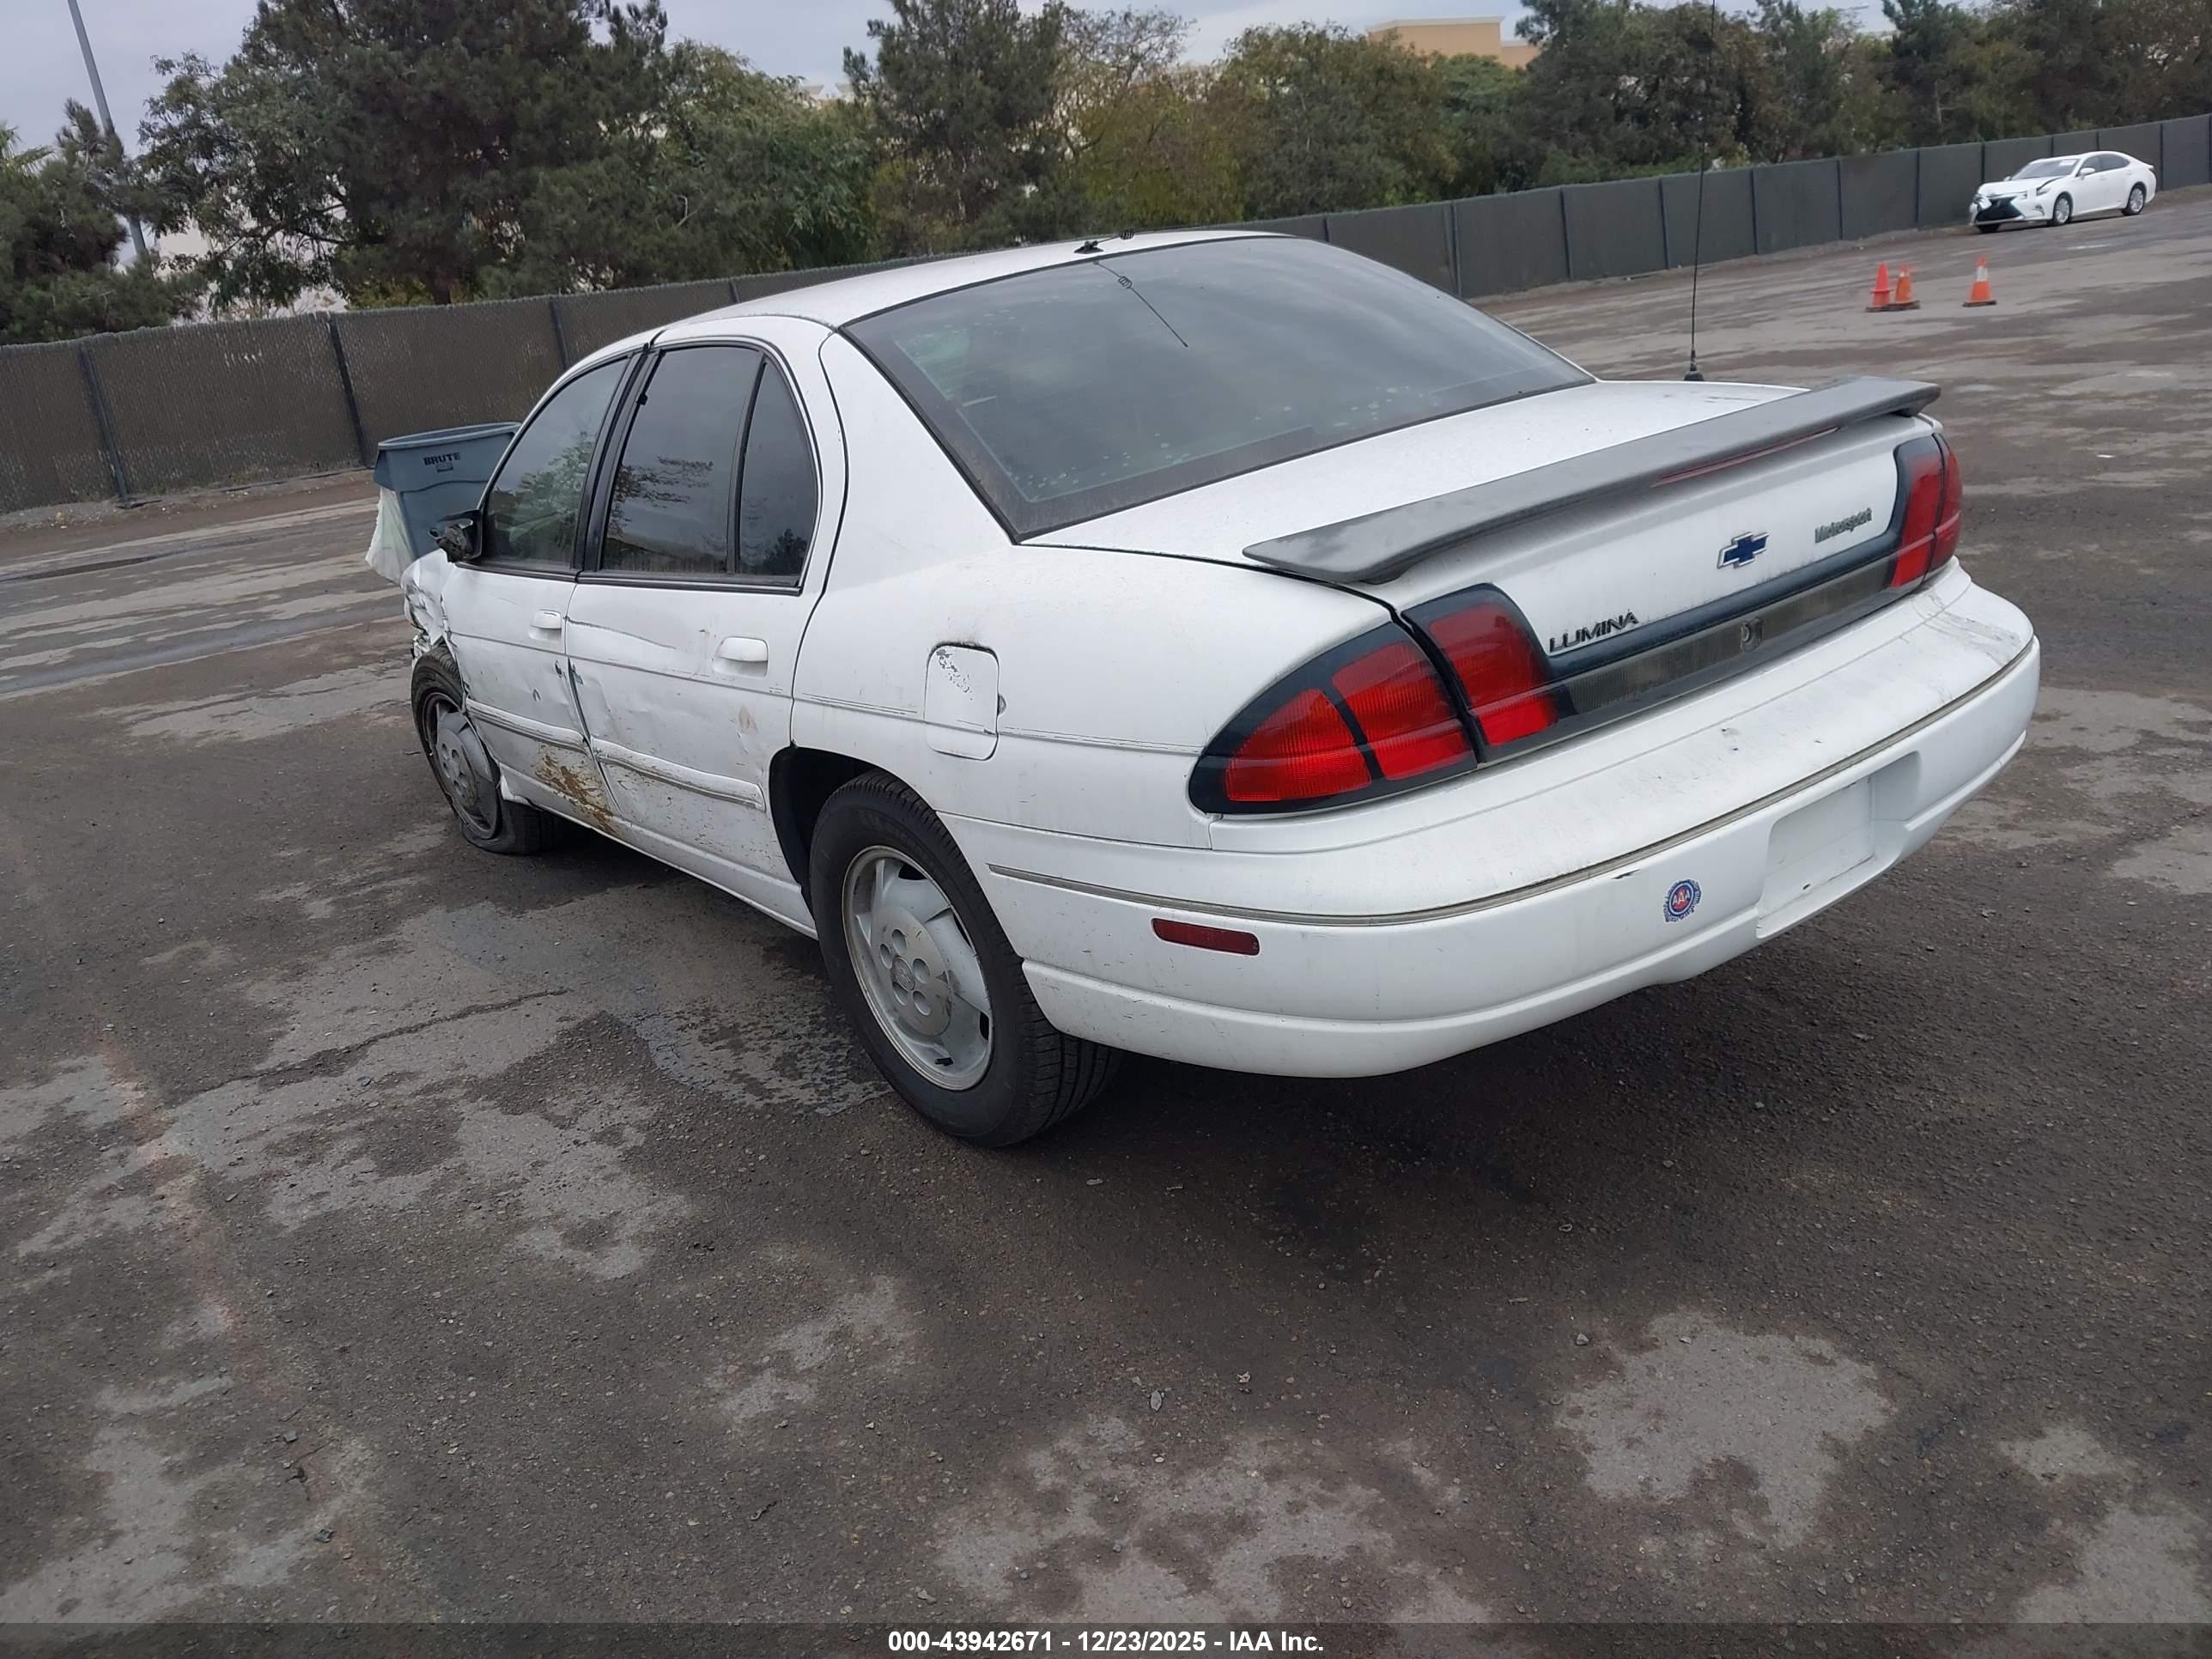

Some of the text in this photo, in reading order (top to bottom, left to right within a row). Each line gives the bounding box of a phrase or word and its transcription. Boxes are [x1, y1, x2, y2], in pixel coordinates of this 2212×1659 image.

[423, 452, 461, 465] BRUTE
[1815, 507, 1873, 544] Motorsport
[1549, 611, 1639, 653] LUMINA
[1672, 888, 1691, 906] AAA
